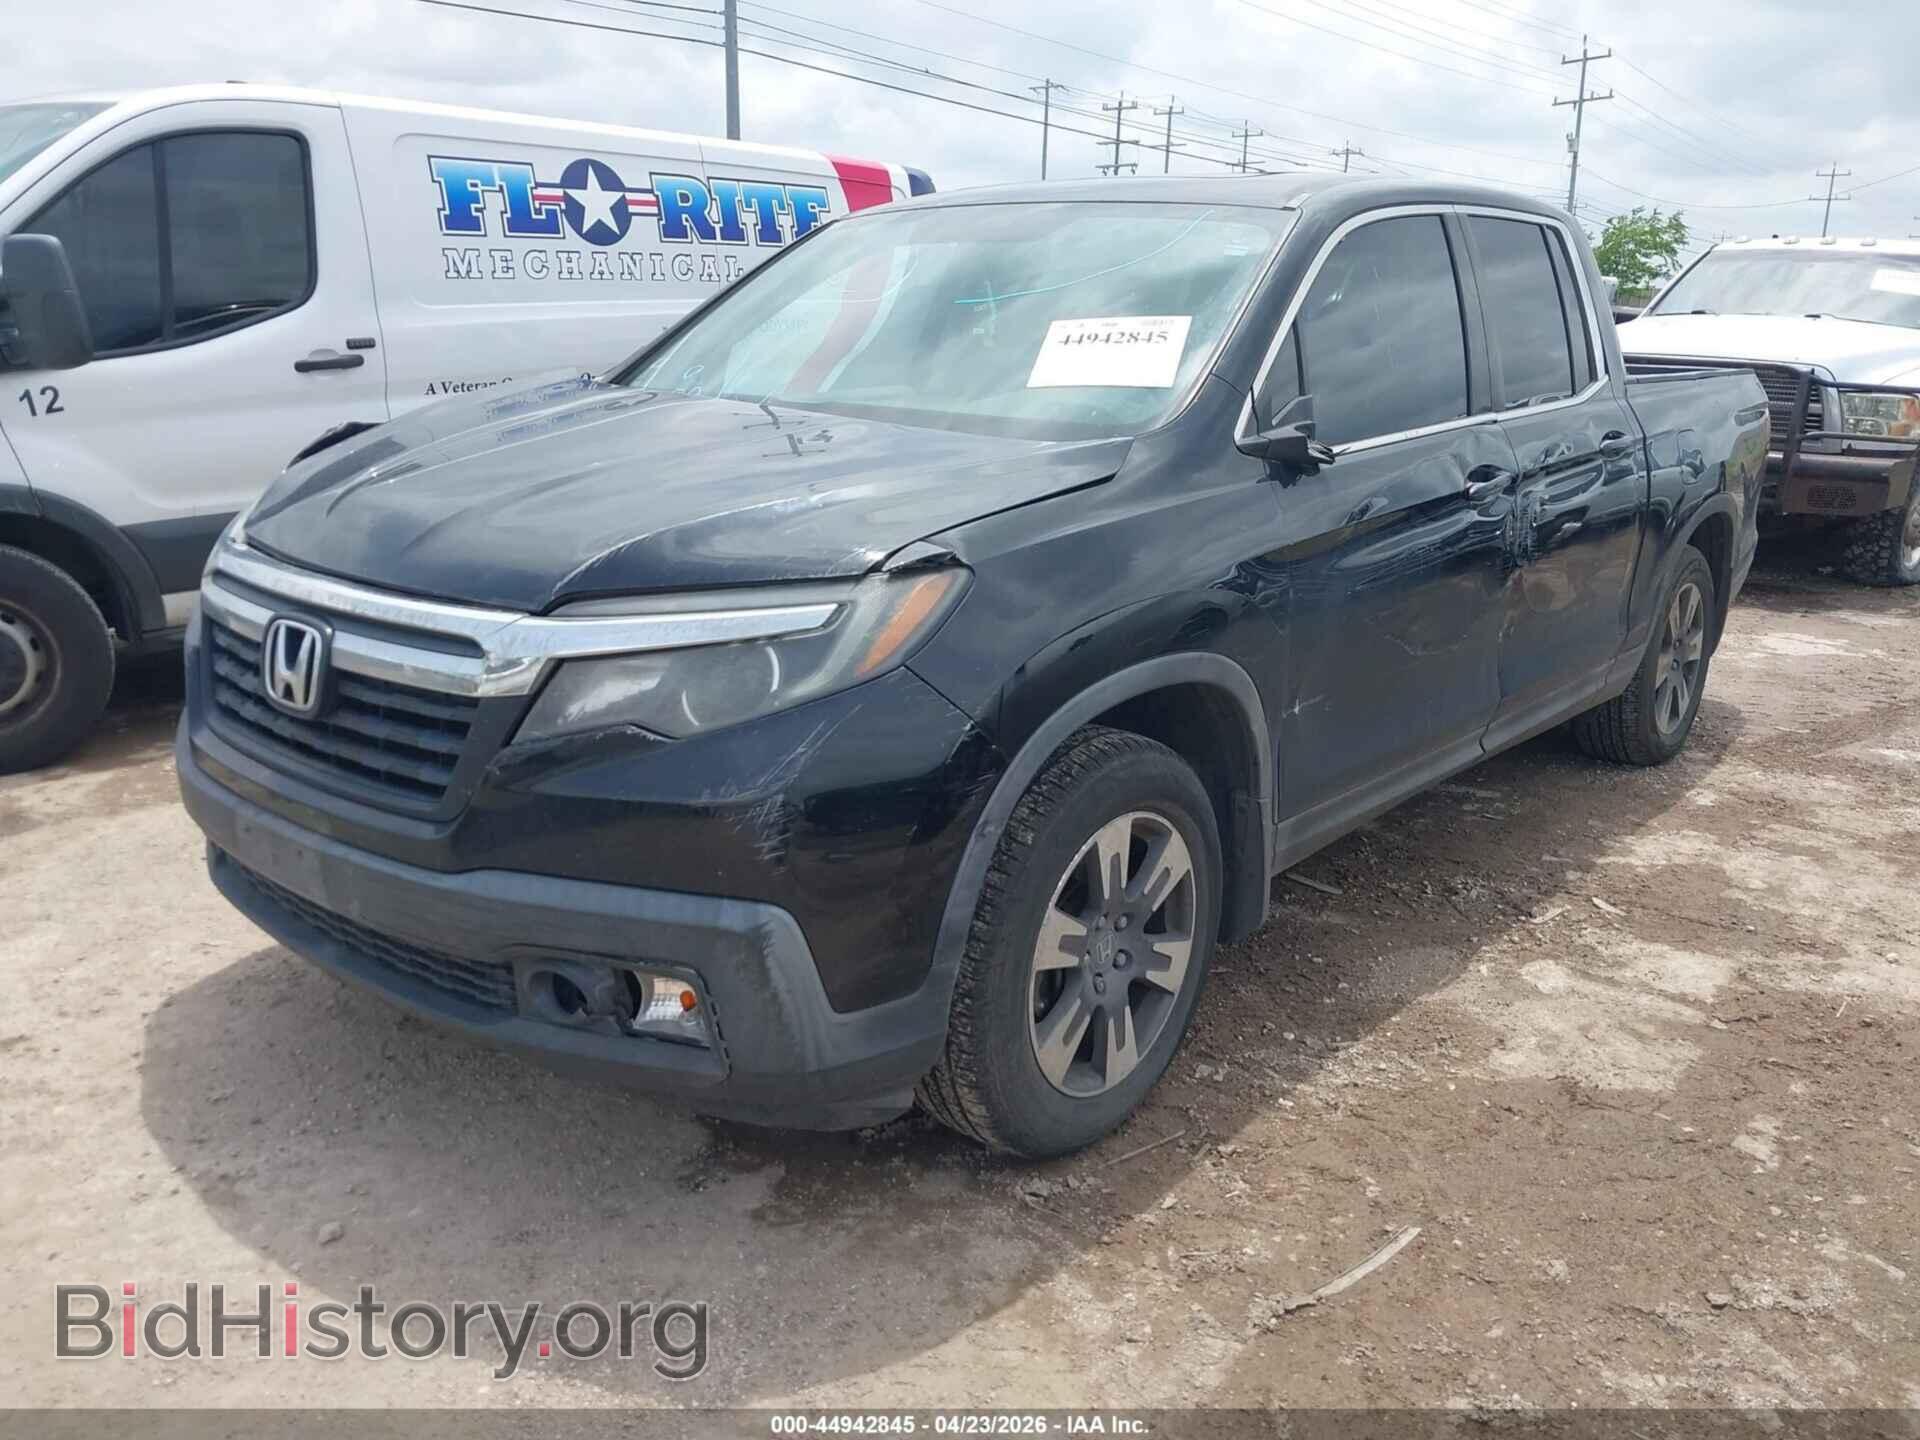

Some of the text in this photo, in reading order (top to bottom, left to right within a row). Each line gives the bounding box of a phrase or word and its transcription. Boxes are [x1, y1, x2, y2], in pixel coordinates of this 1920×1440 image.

[442, 247, 744, 283] MECHANICAL
[1059, 331, 1169, 345] 44942845
[424, 382, 436, 396] A
[19, 385, 64, 417] 12
